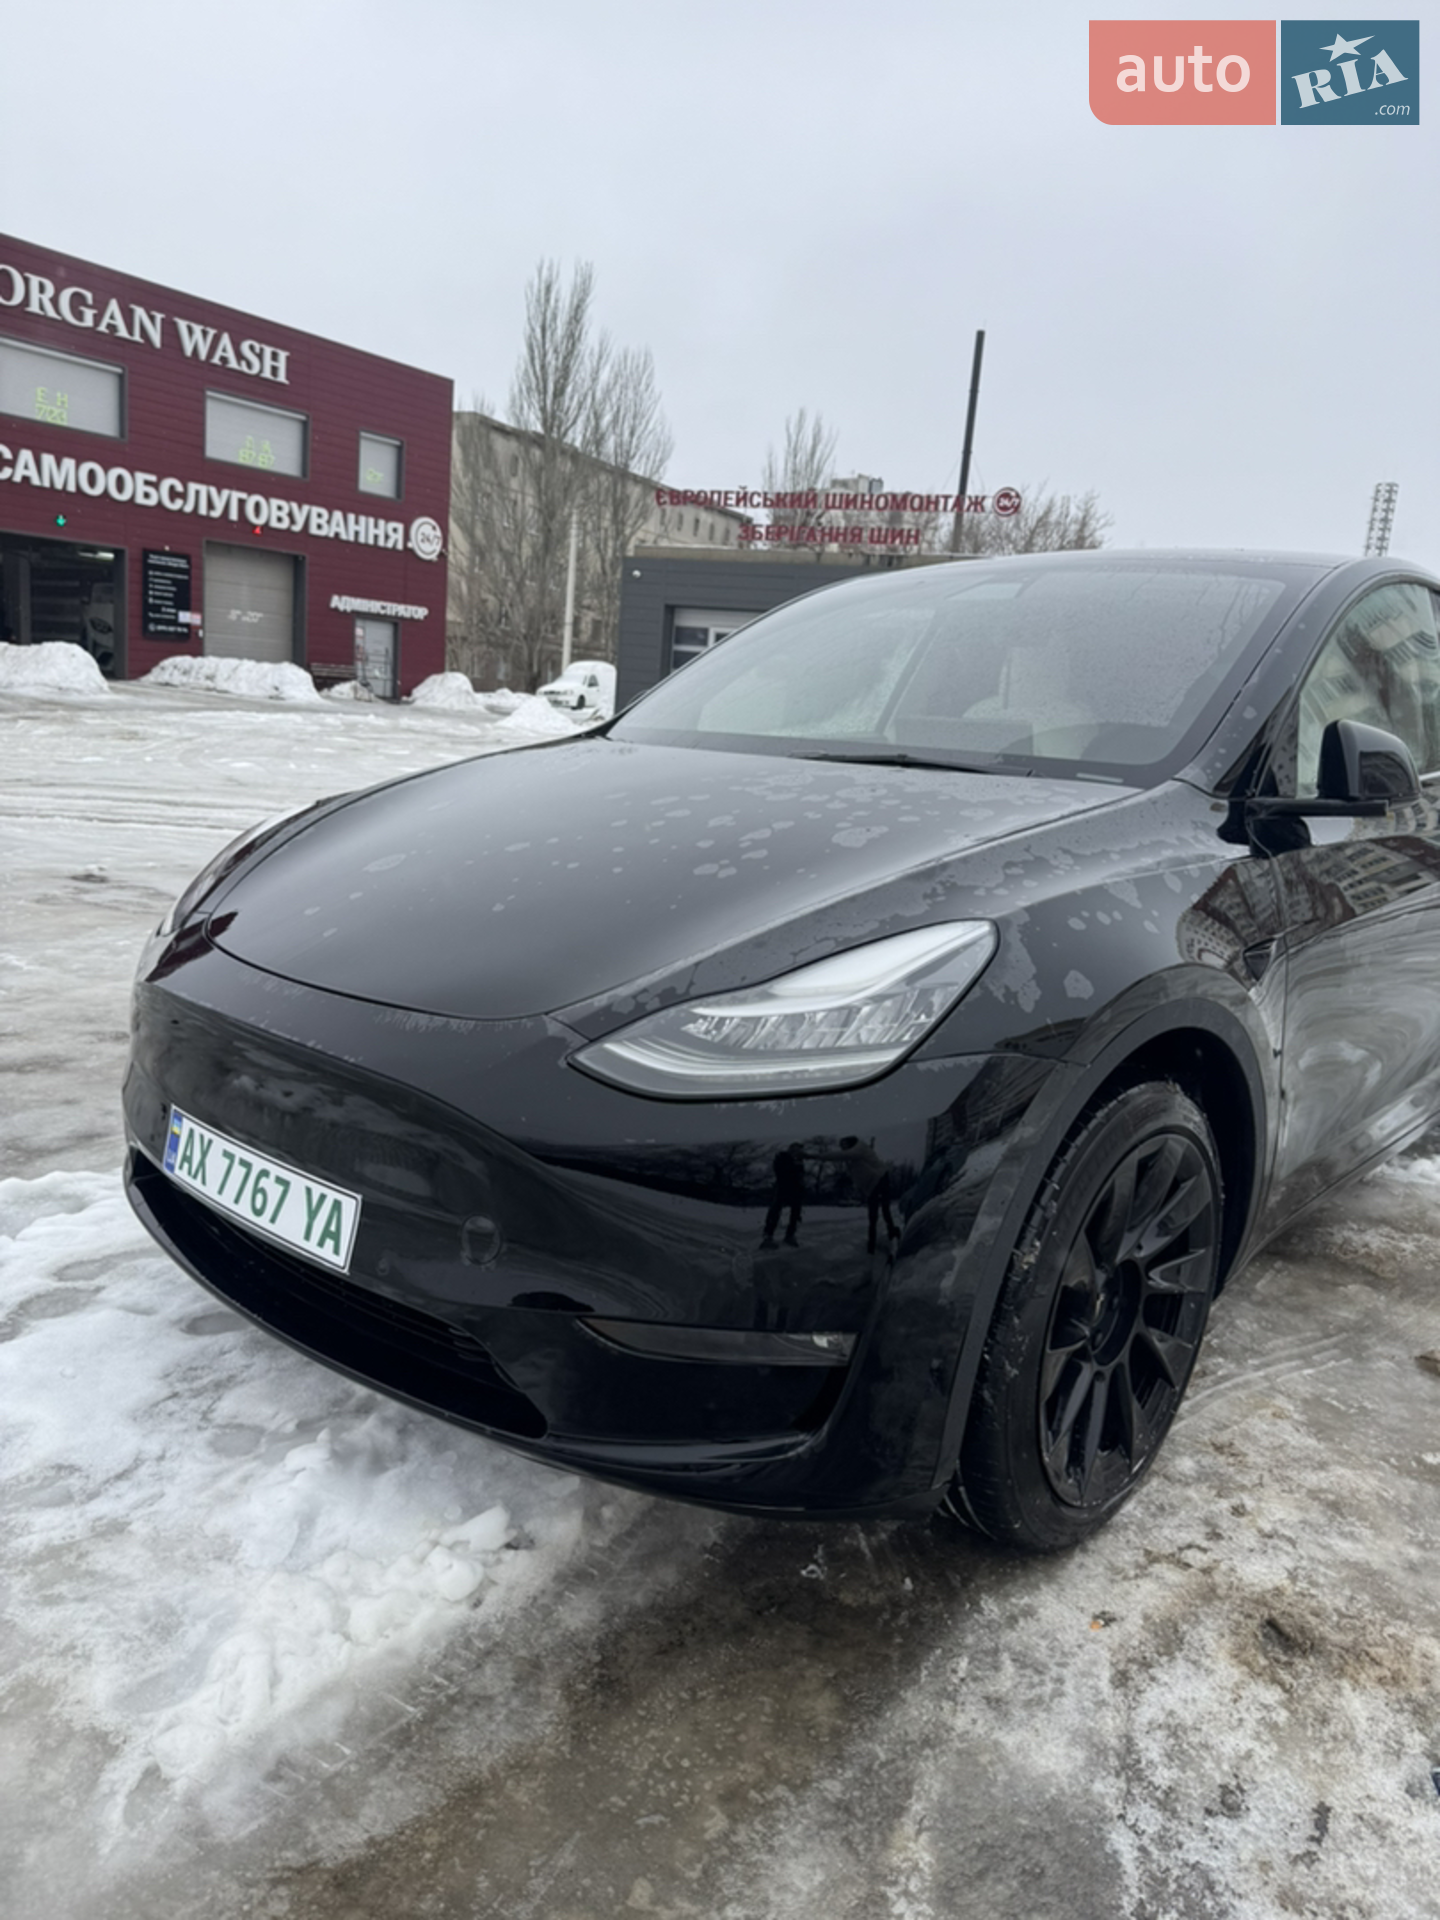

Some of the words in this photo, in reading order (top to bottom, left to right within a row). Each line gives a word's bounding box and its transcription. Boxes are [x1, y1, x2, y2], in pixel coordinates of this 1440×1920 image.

[0, 264, 165, 349] ORGAN
[173, 316, 290, 384] WASH
[655, 485, 818, 510] ЄВРОПЕЙСЬКИЙ
[824, 492, 987, 513] ШИНОМОНТАЖ
[737, 523, 863, 544] ЗБЕРІГАННЯ
[868, 526, 921, 545] ШИН
[178, 1127, 213, 1187] AX
[216, 1148, 291, 1225] 7767
[303, 1185, 343, 1257] YA
